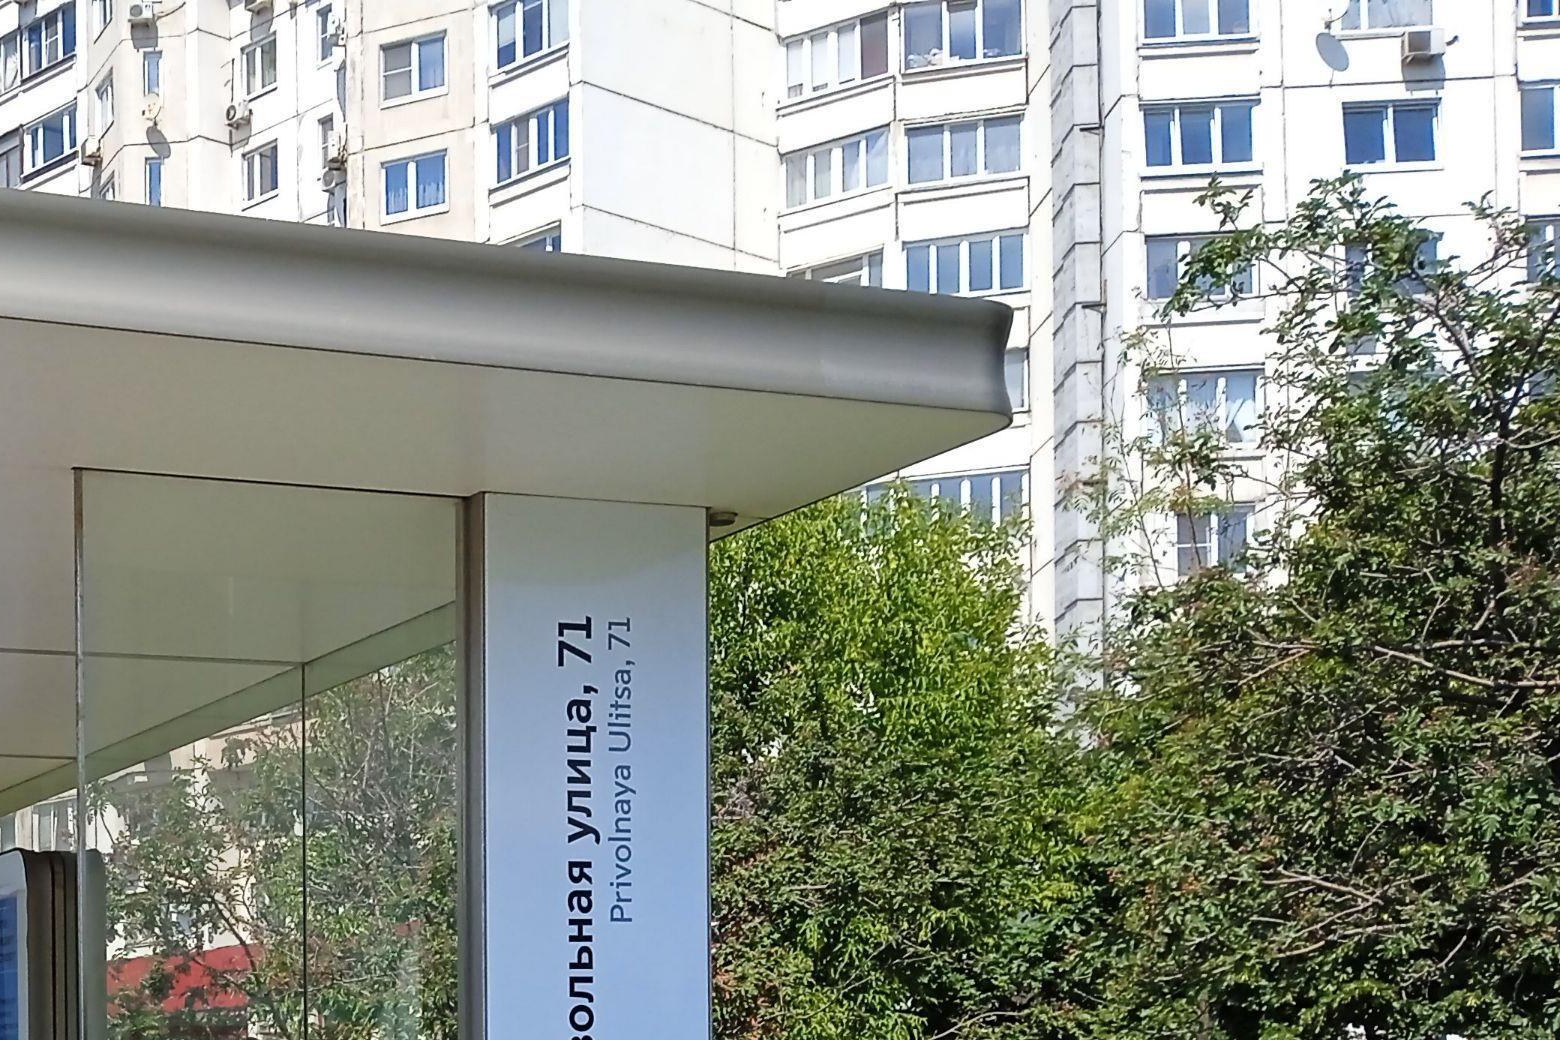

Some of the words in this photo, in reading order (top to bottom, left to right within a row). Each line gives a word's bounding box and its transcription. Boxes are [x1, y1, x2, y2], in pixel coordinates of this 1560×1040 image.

[557, 615, 592, 667] 71
[607, 616, 631, 650] 71
[607, 660, 636, 752] Ulitsa,
[566, 684, 601, 845] улица,
[607, 765, 637, 922] Privolnaya
